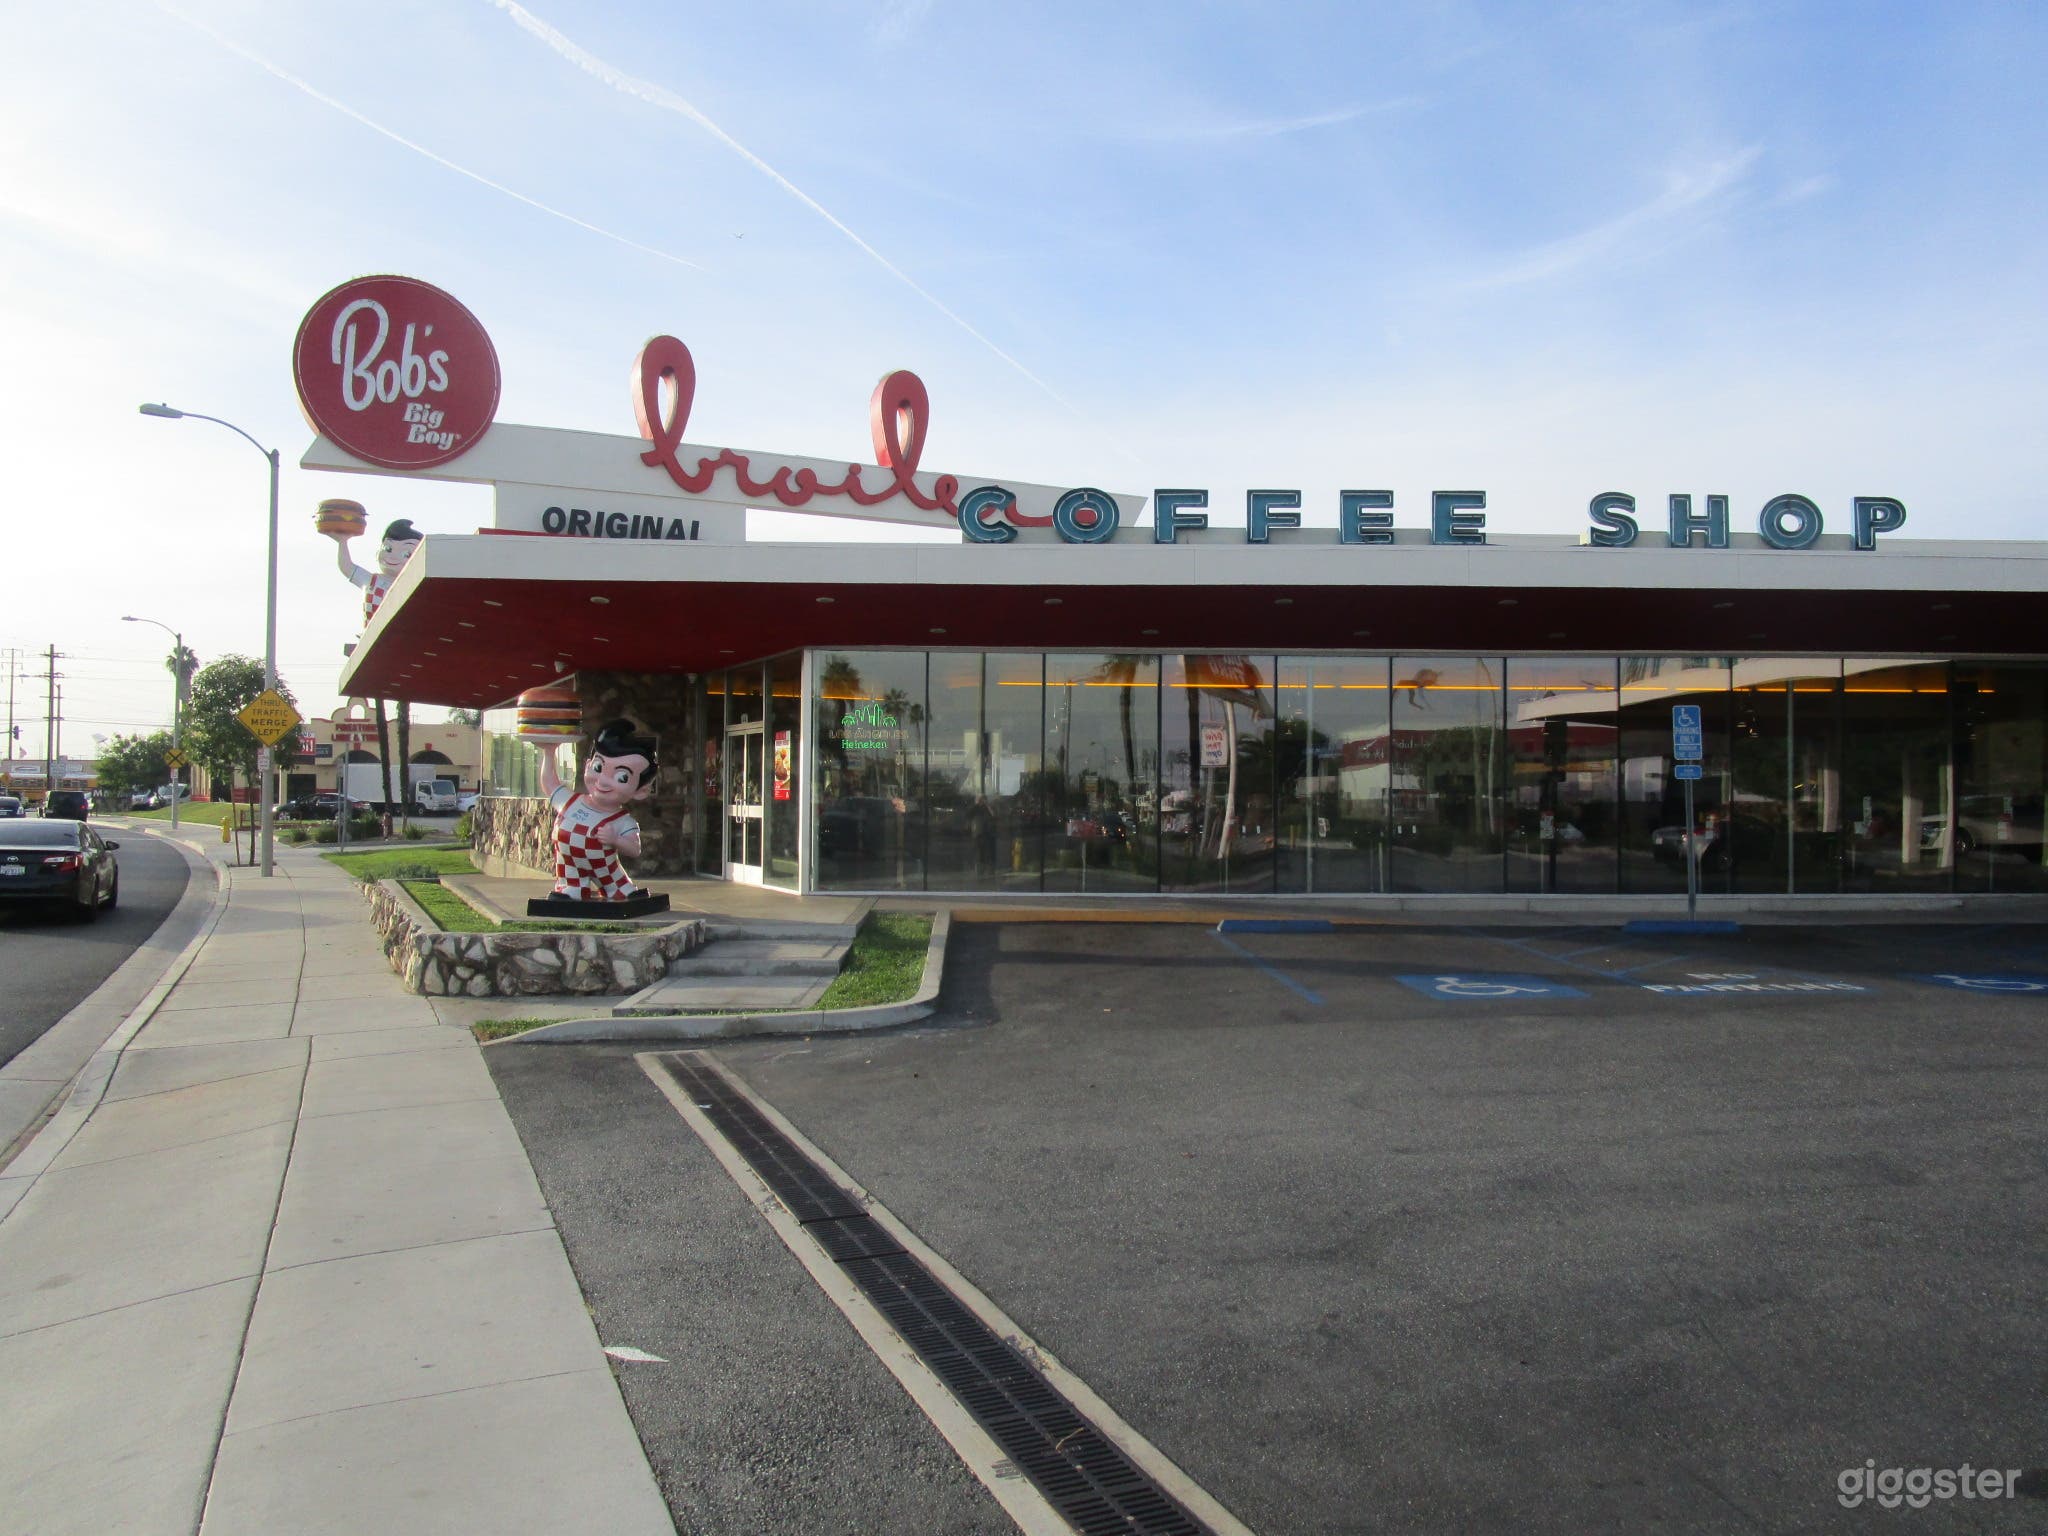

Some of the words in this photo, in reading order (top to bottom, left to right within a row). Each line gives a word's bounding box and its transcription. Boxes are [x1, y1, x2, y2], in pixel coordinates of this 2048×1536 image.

[331, 298, 449, 411] Bob's
[402, 402, 445, 428] Big
[957, 485, 1487, 545] COFFEE
[1588, 491, 1907, 551] SHOP
[252, 709, 288, 717] TRAFFIC
[251, 719, 287, 727] MERGE
[841, 739, 887, 749] Heineken
[572, 813, 587, 822] BOY
[577, 808, 590, 818] BIG
[1641, 983, 1865, 992] PARKING
